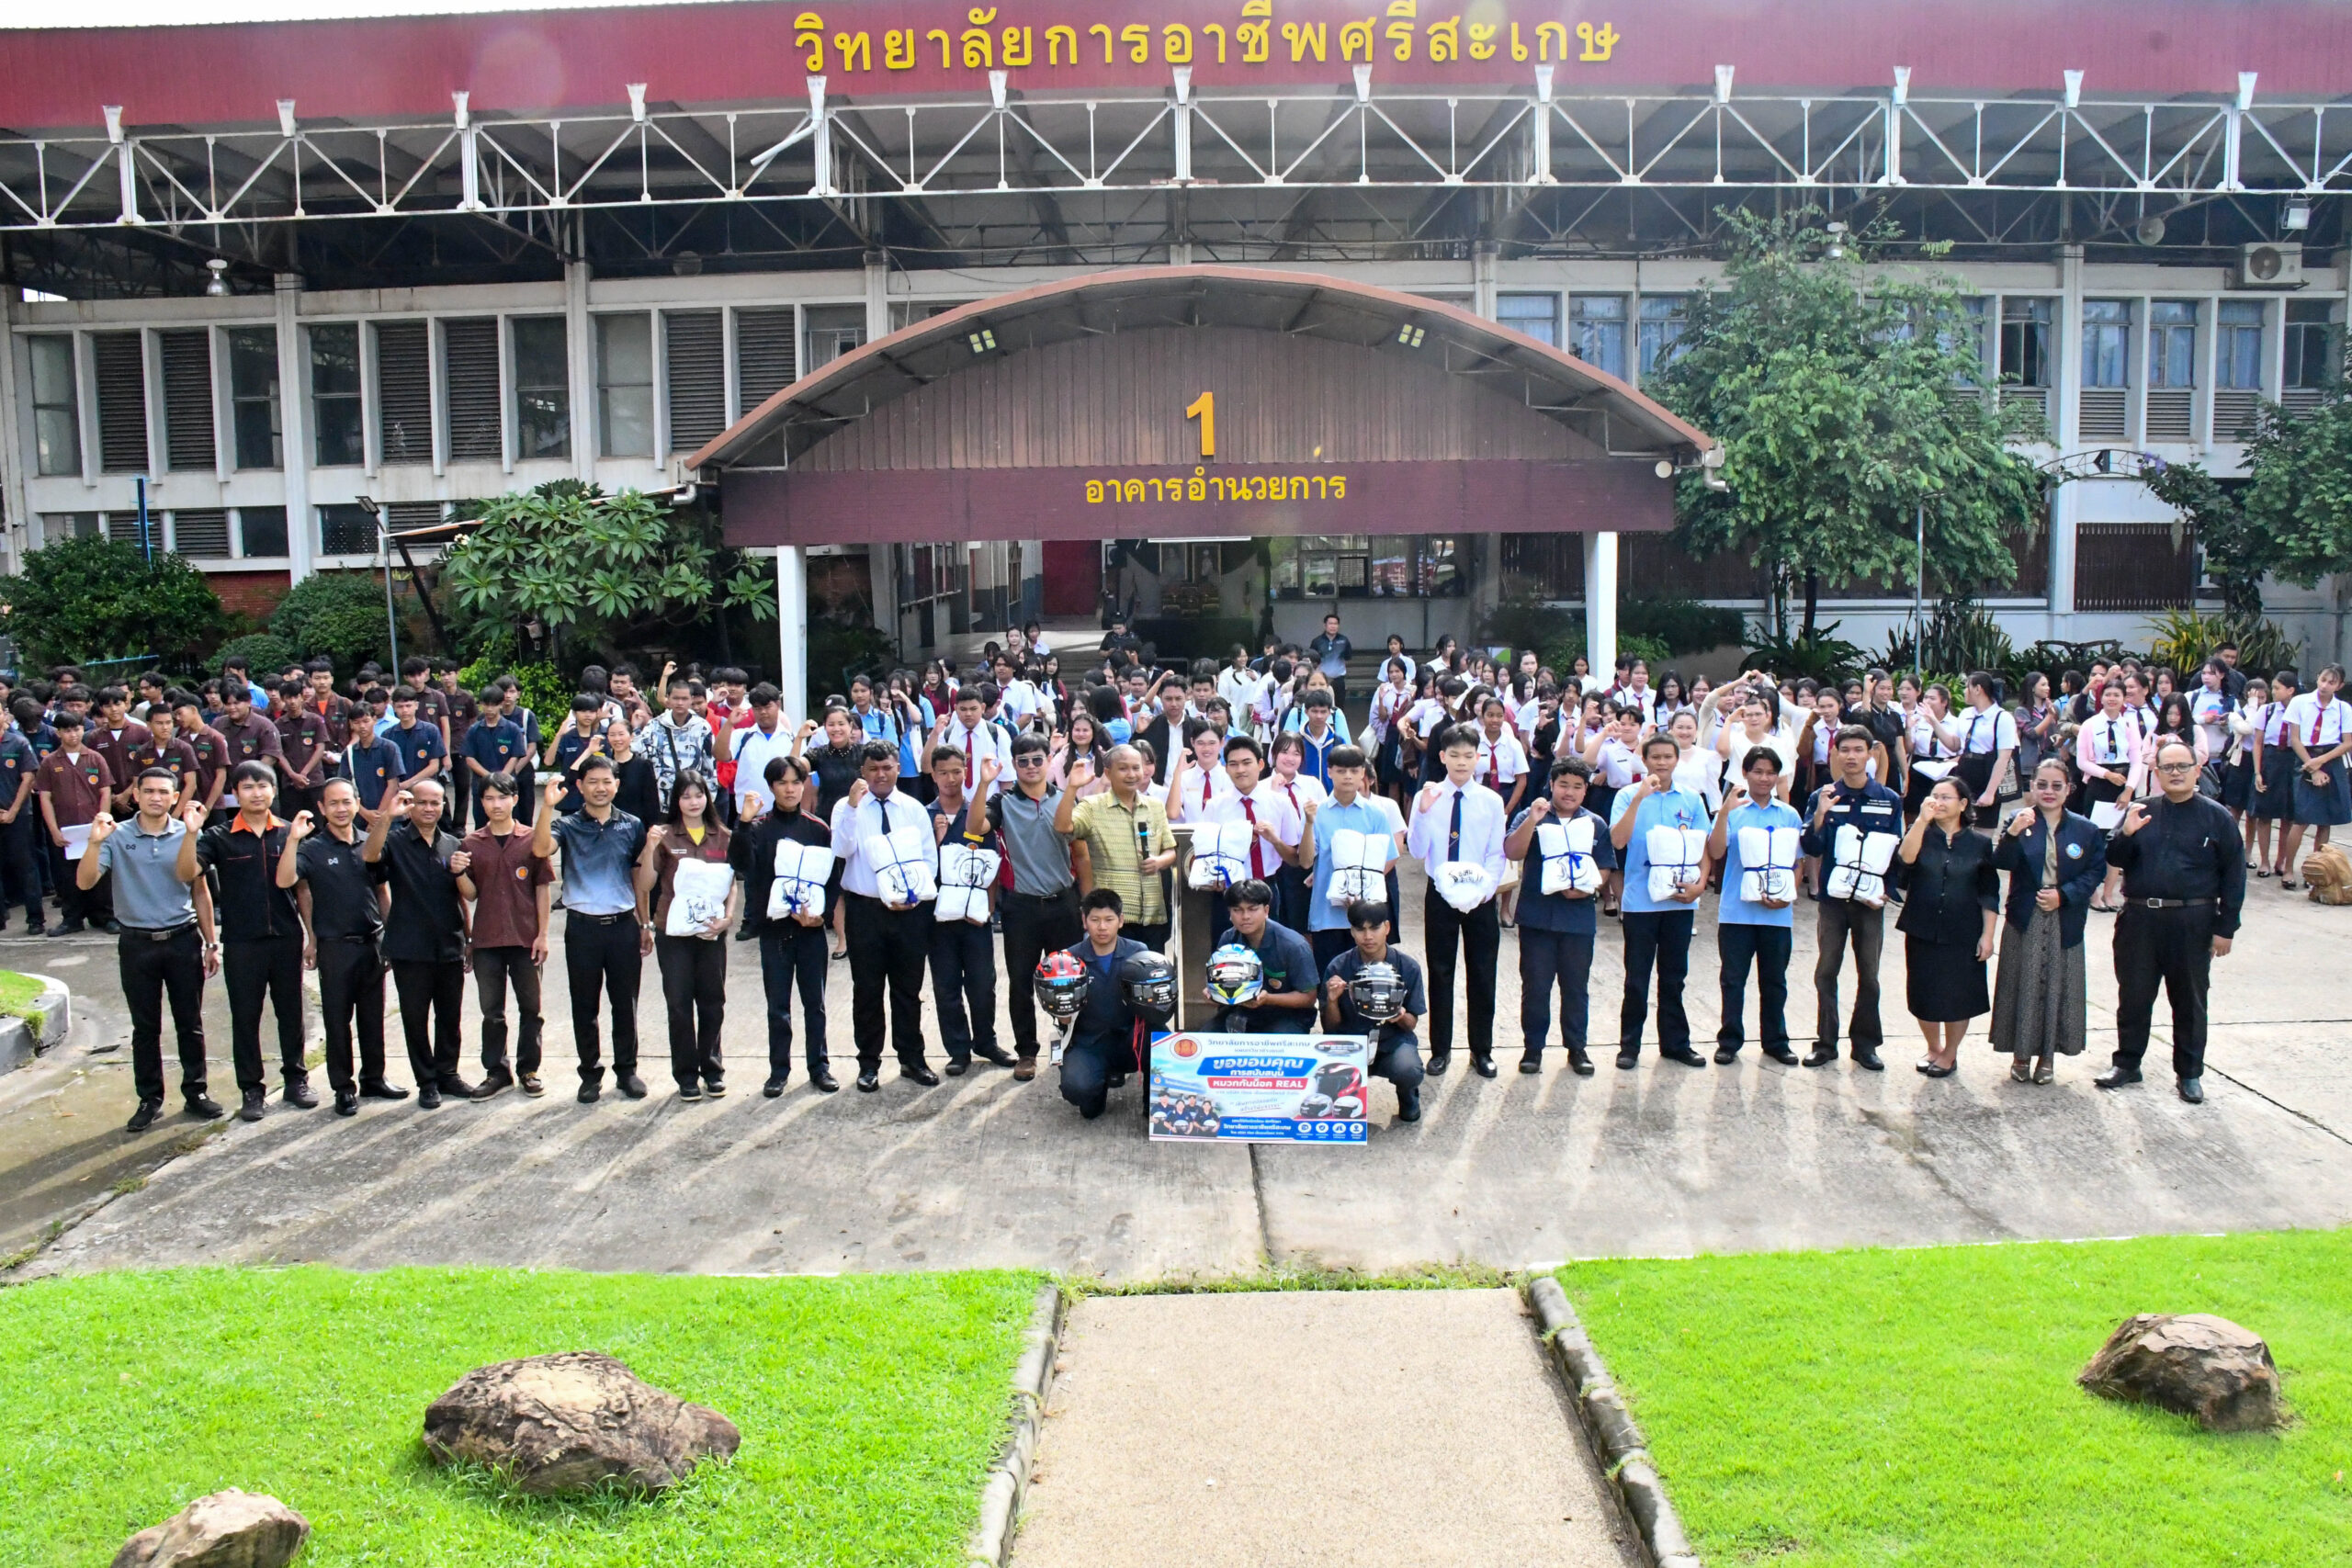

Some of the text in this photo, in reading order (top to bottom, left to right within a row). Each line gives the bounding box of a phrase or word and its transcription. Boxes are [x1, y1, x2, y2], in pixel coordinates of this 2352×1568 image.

[794, 0, 1621, 72] วิทยาลัยการอาชีพศรีสะเกษ
[1186, 391, 1216, 457] 1
[1084, 466, 1347, 503] อาคารอำนวยการ
[1213, 1057, 1305, 1070] ขอขอบคุณ
[1230, 1068, 1284, 1077] การสนับสนุน
[1276, 1079, 1305, 1089] REAL
